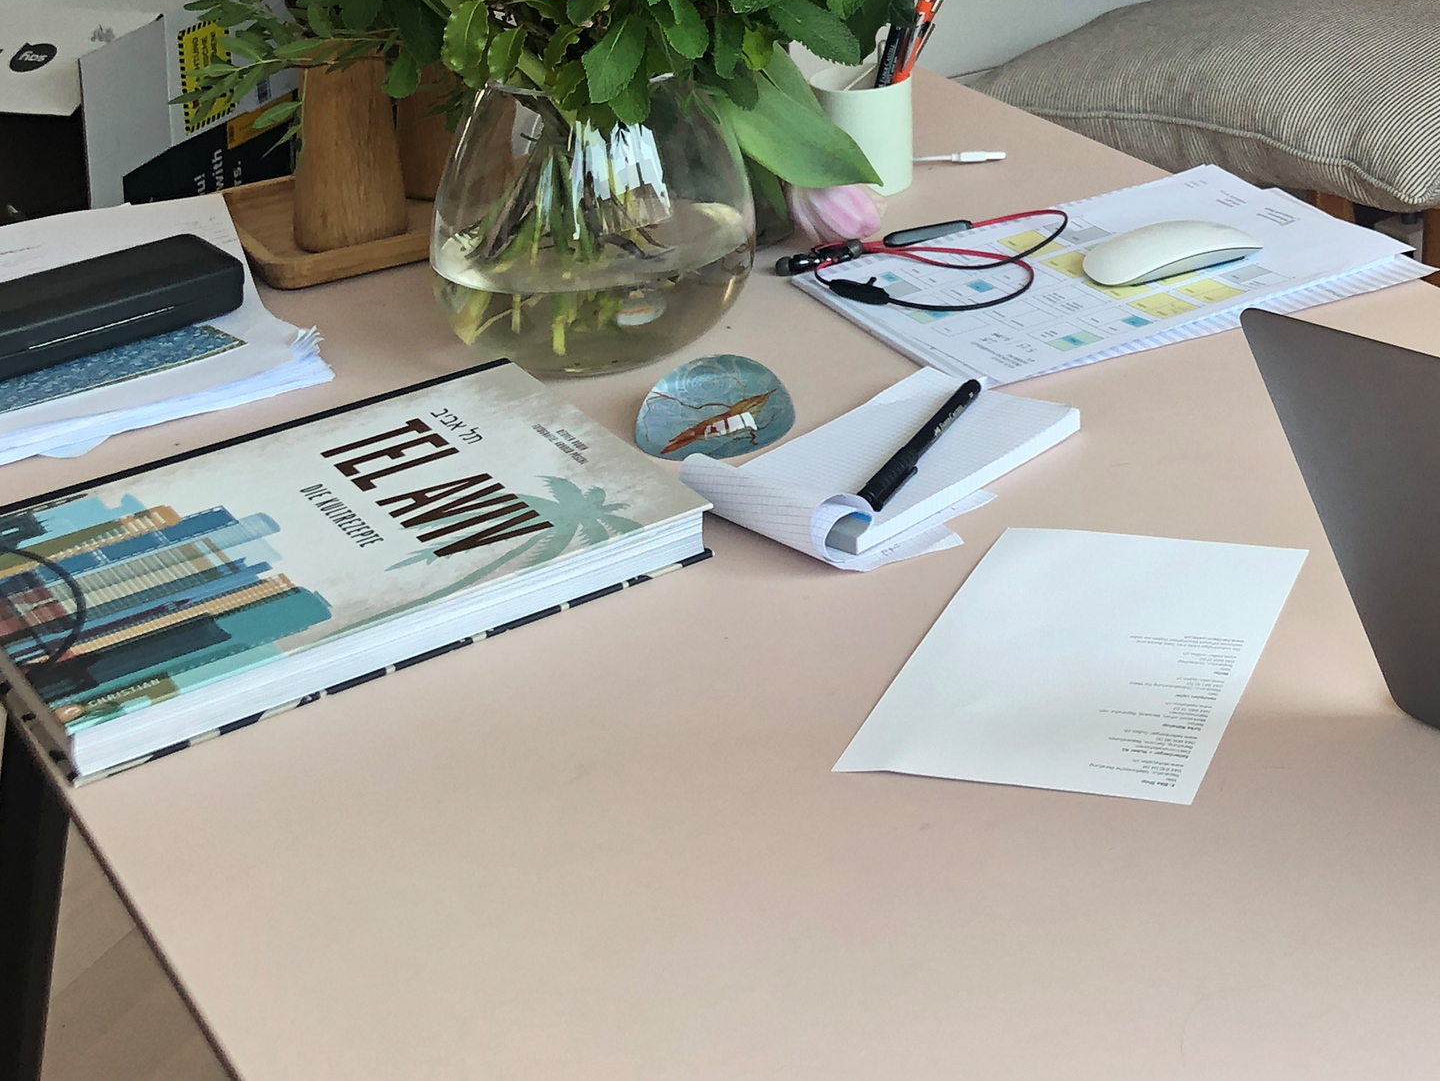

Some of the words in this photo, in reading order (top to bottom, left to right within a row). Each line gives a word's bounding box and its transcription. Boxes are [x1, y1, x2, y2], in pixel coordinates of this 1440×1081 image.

[430, 407, 467, 431] אביב
[458, 426, 484, 445] תל
[320, 418, 460, 492] TEL
[300, 483, 331, 501] DIE
[315, 494, 384, 548] KULTREZEPTE
[375, 473, 555, 558] AVIV
[87, 678, 160, 708] CHRISTIAN
